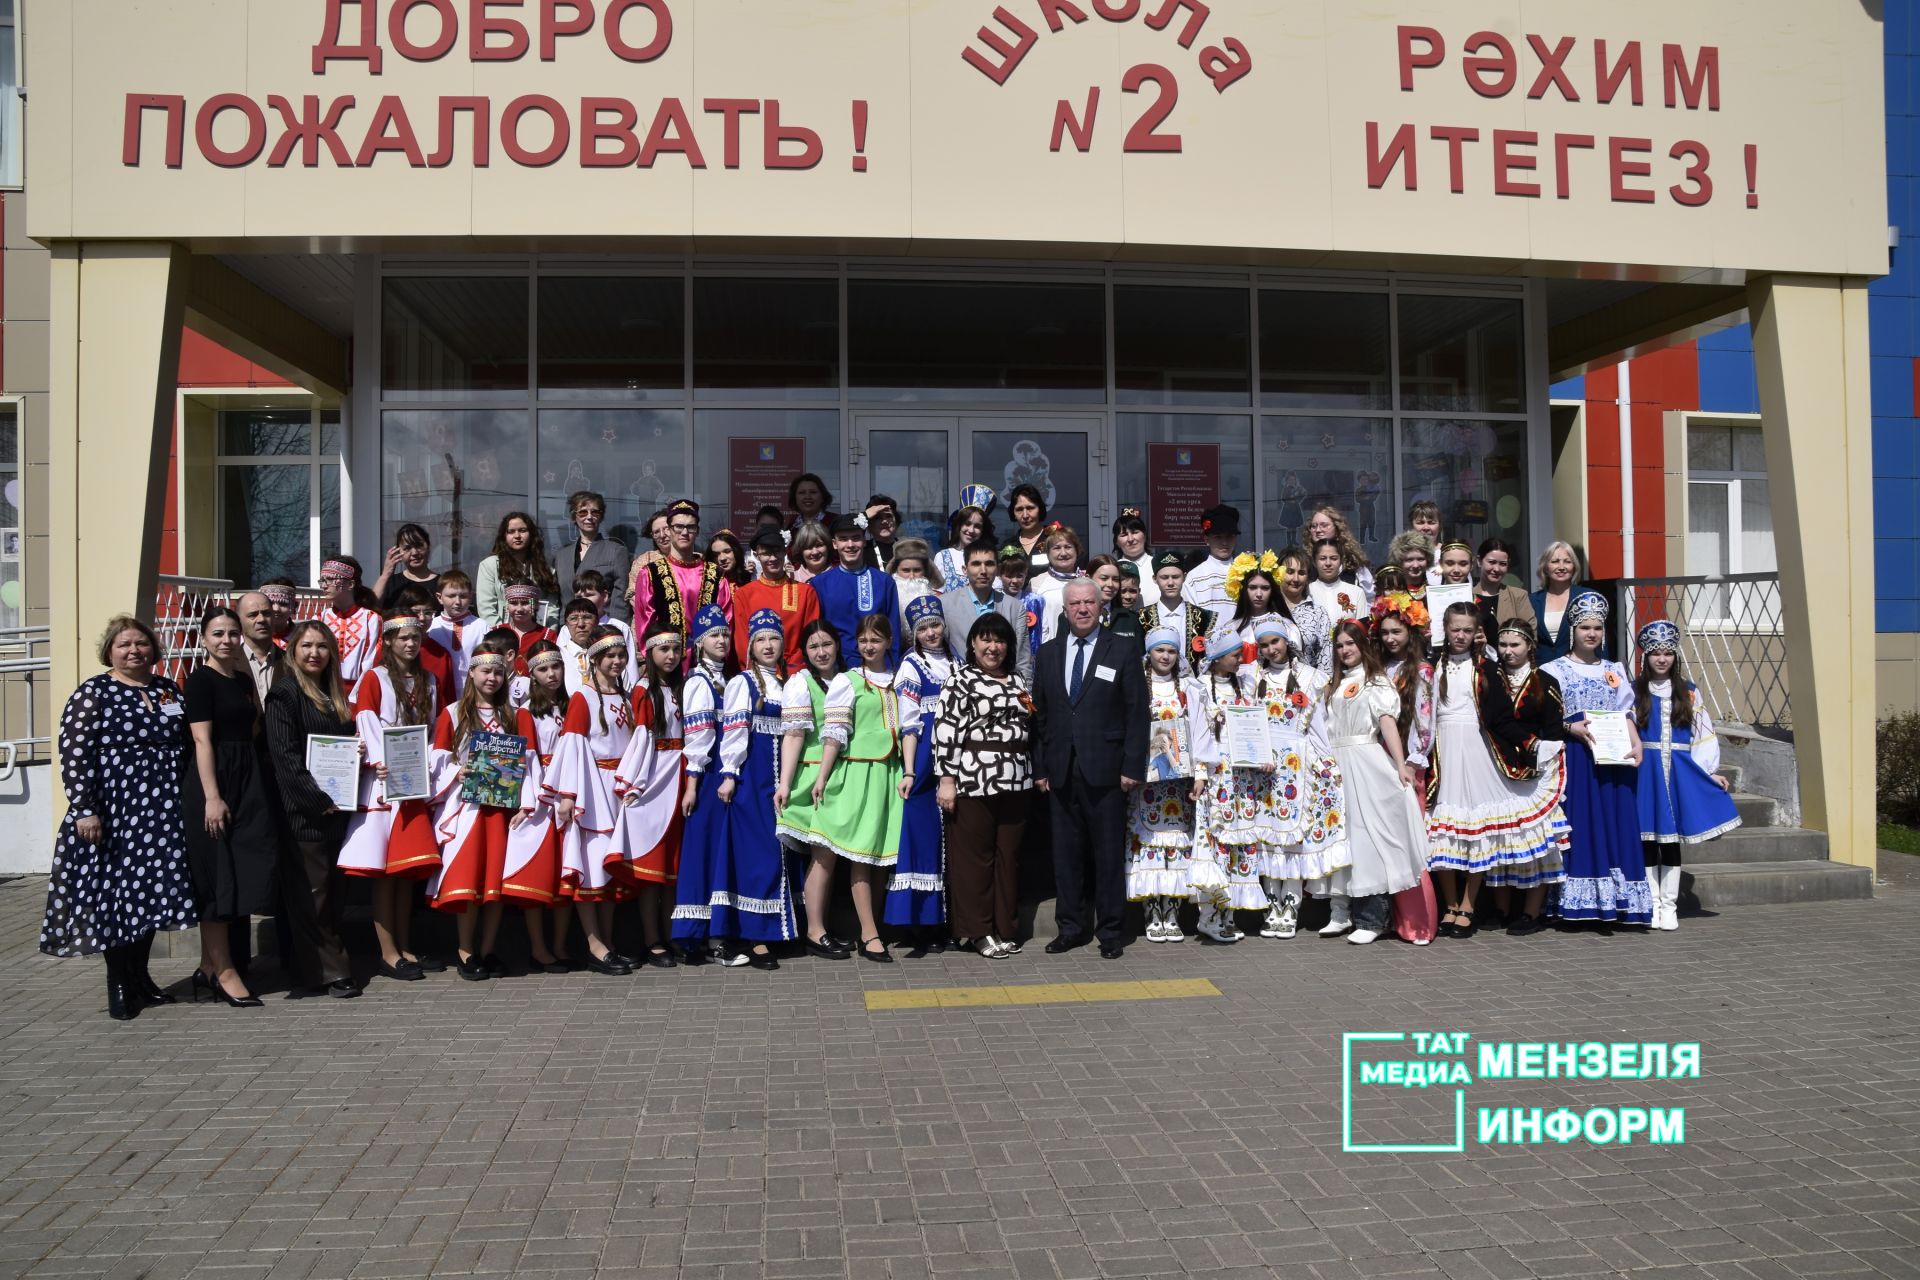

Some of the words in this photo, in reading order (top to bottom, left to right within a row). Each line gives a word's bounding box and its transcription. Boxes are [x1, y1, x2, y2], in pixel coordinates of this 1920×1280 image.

[312, 0, 672, 74] ДОБРО
[1397, 25, 1721, 110] РӘХИМ
[122, 93, 824, 170] ПОЖАЛОВАТЬ
[1365, 121, 1714, 207] ИТЕГЕЗ
